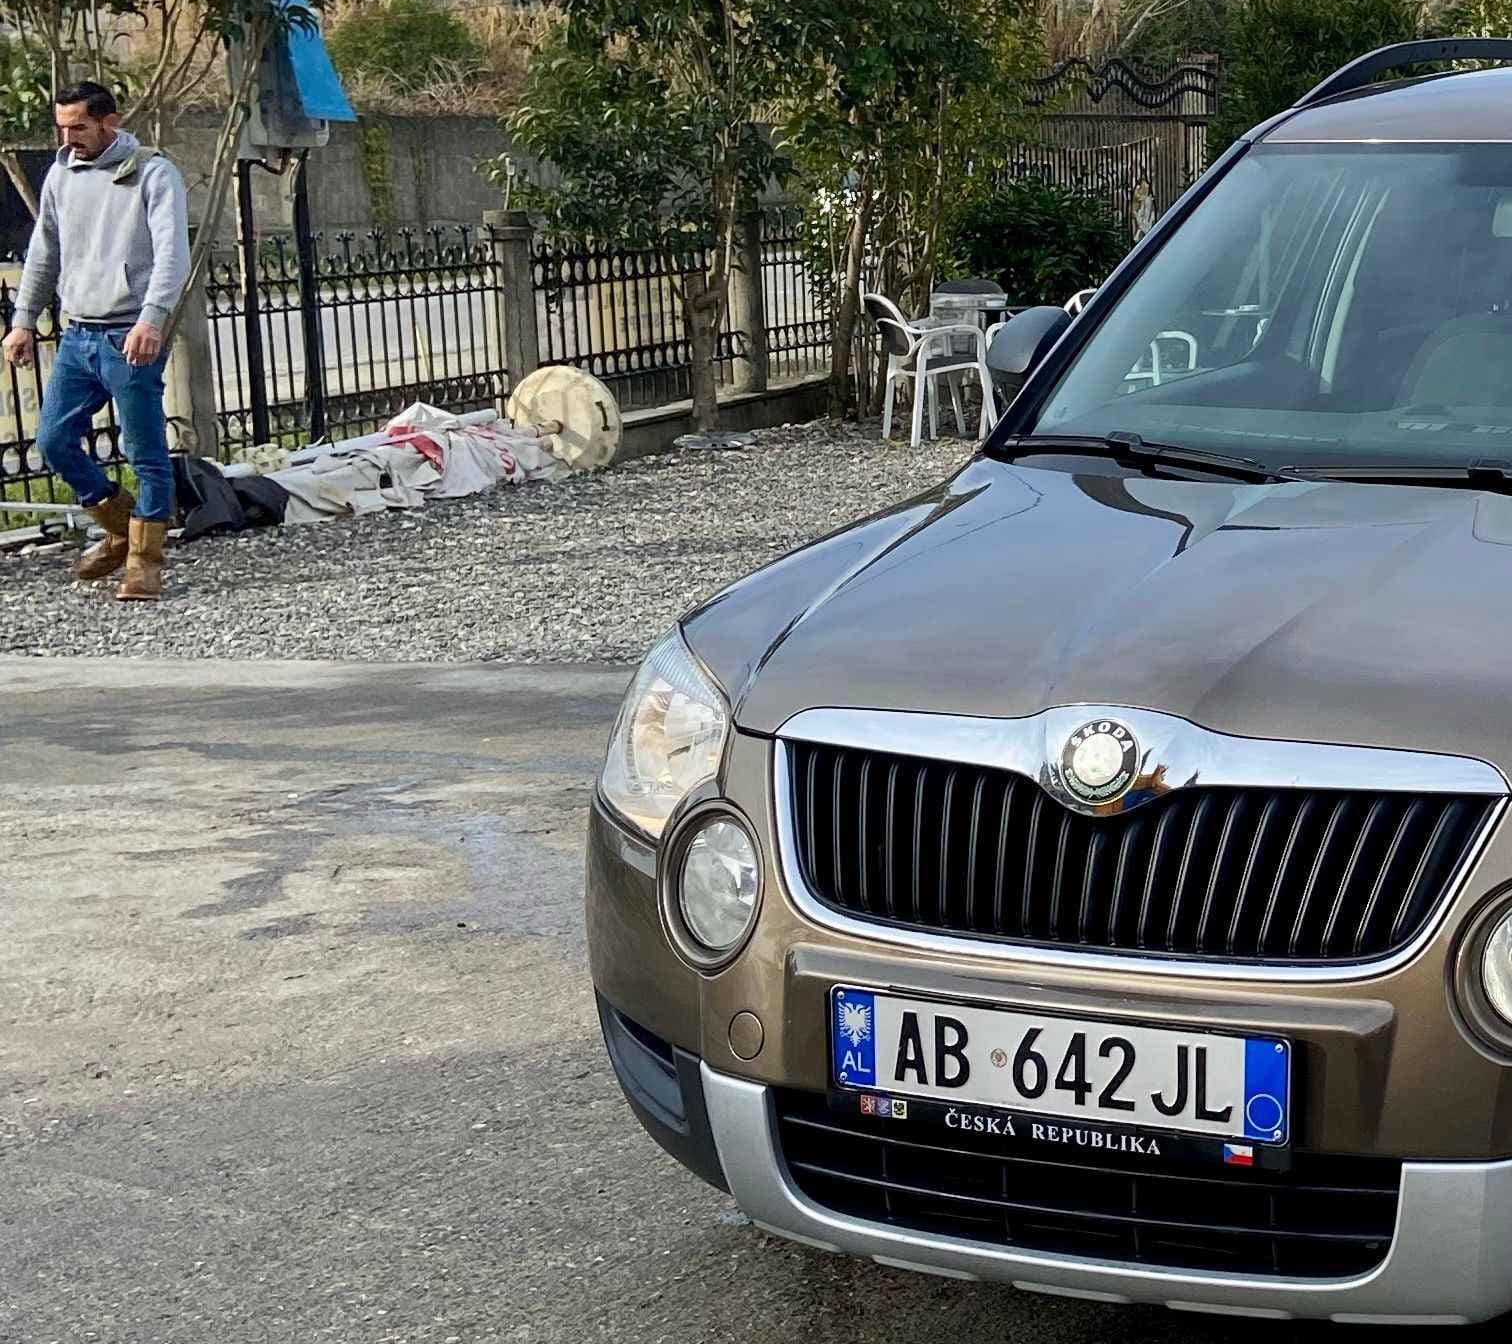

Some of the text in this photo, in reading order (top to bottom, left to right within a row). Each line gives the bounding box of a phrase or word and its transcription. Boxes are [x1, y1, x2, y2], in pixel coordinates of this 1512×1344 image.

[842, 1051, 870, 1074] AL
[893, 1011, 1234, 1122] AB 642 JL
[945, 1108, 1161, 1155] ČESKÁ REPUBLIKA
